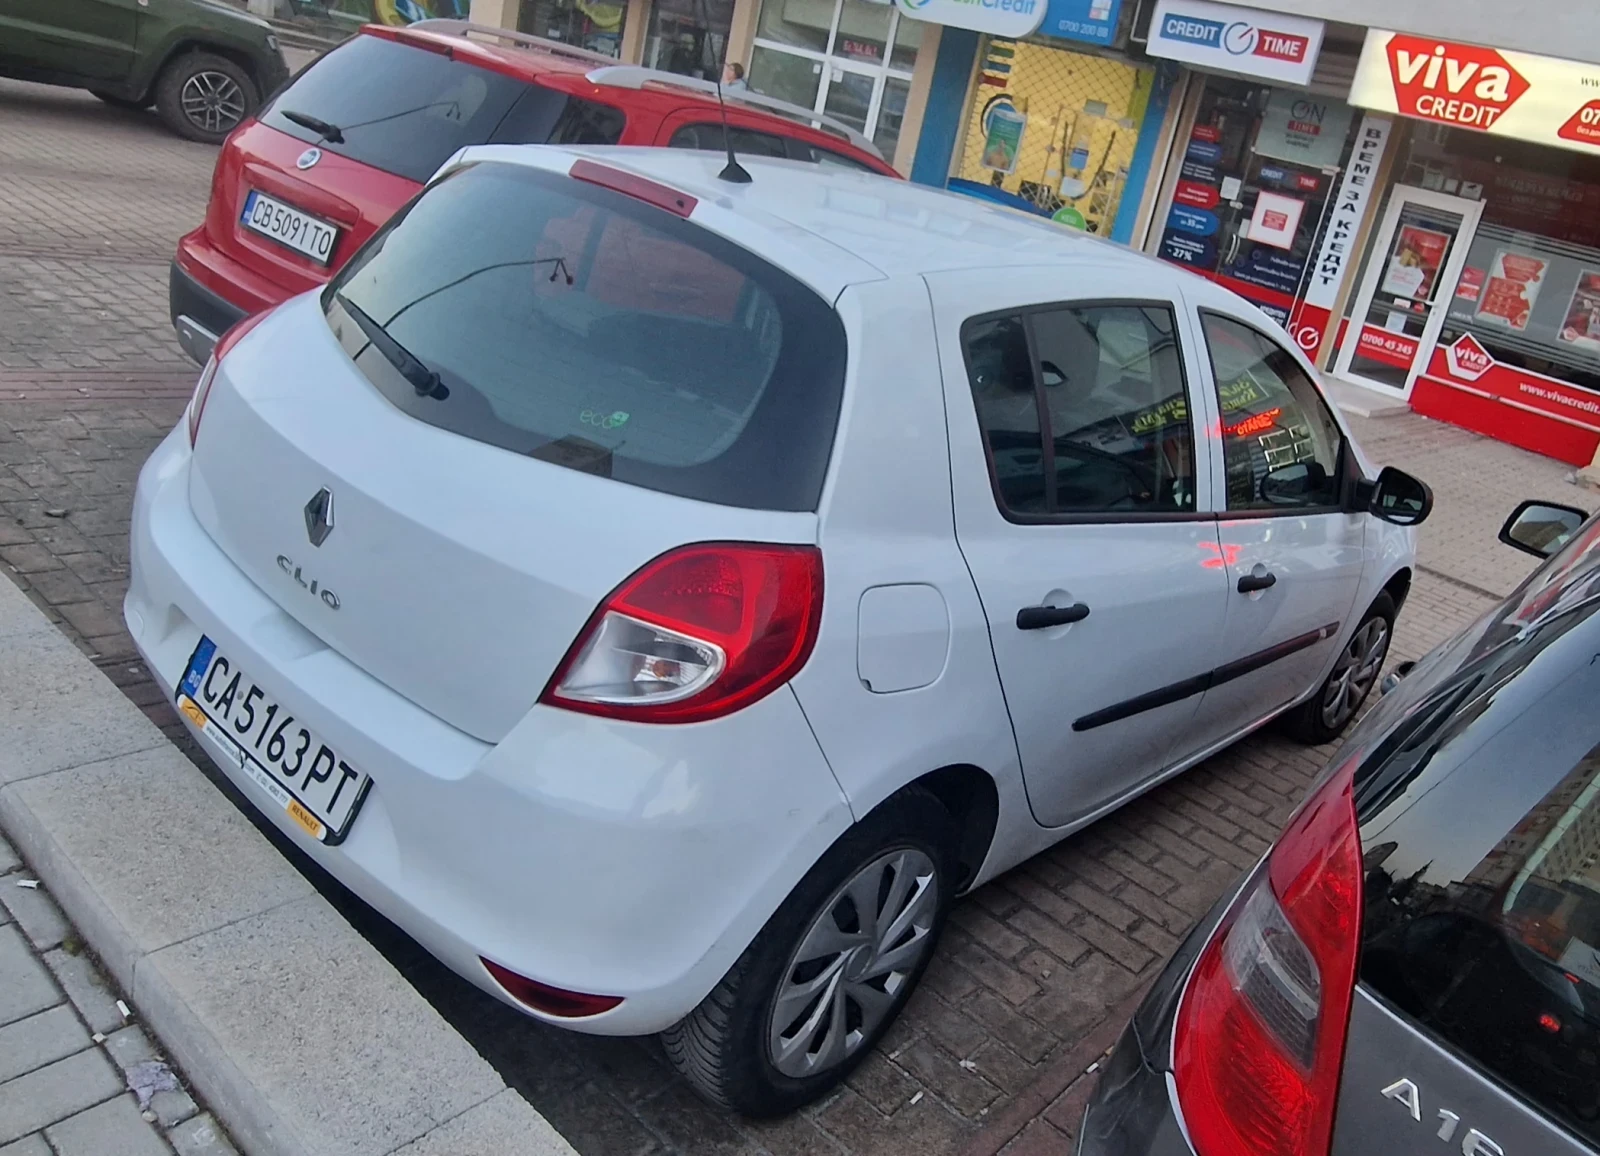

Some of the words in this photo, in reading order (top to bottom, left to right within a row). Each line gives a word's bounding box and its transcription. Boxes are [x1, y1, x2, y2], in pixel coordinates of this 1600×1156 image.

[1167, 19, 1219, 41] CREDIT
[1263, 35, 1302, 57] TIME
[1396, 45, 1511, 102] viva
[1416, 95, 1501, 128] CREDIT
[1261, 167, 1284, 180] CREDIT
[1300, 176, 1317, 188] TIME
[1319, 219, 1352, 284] КРЕДИТ
[1362, 332, 1385, 347] 0700
[1384, 339, 1397, 351] 45
[1456, 346, 1488, 366] viva
[276, 553, 341, 611] CLIO
[291, 804, 319, 832] RENAULT
